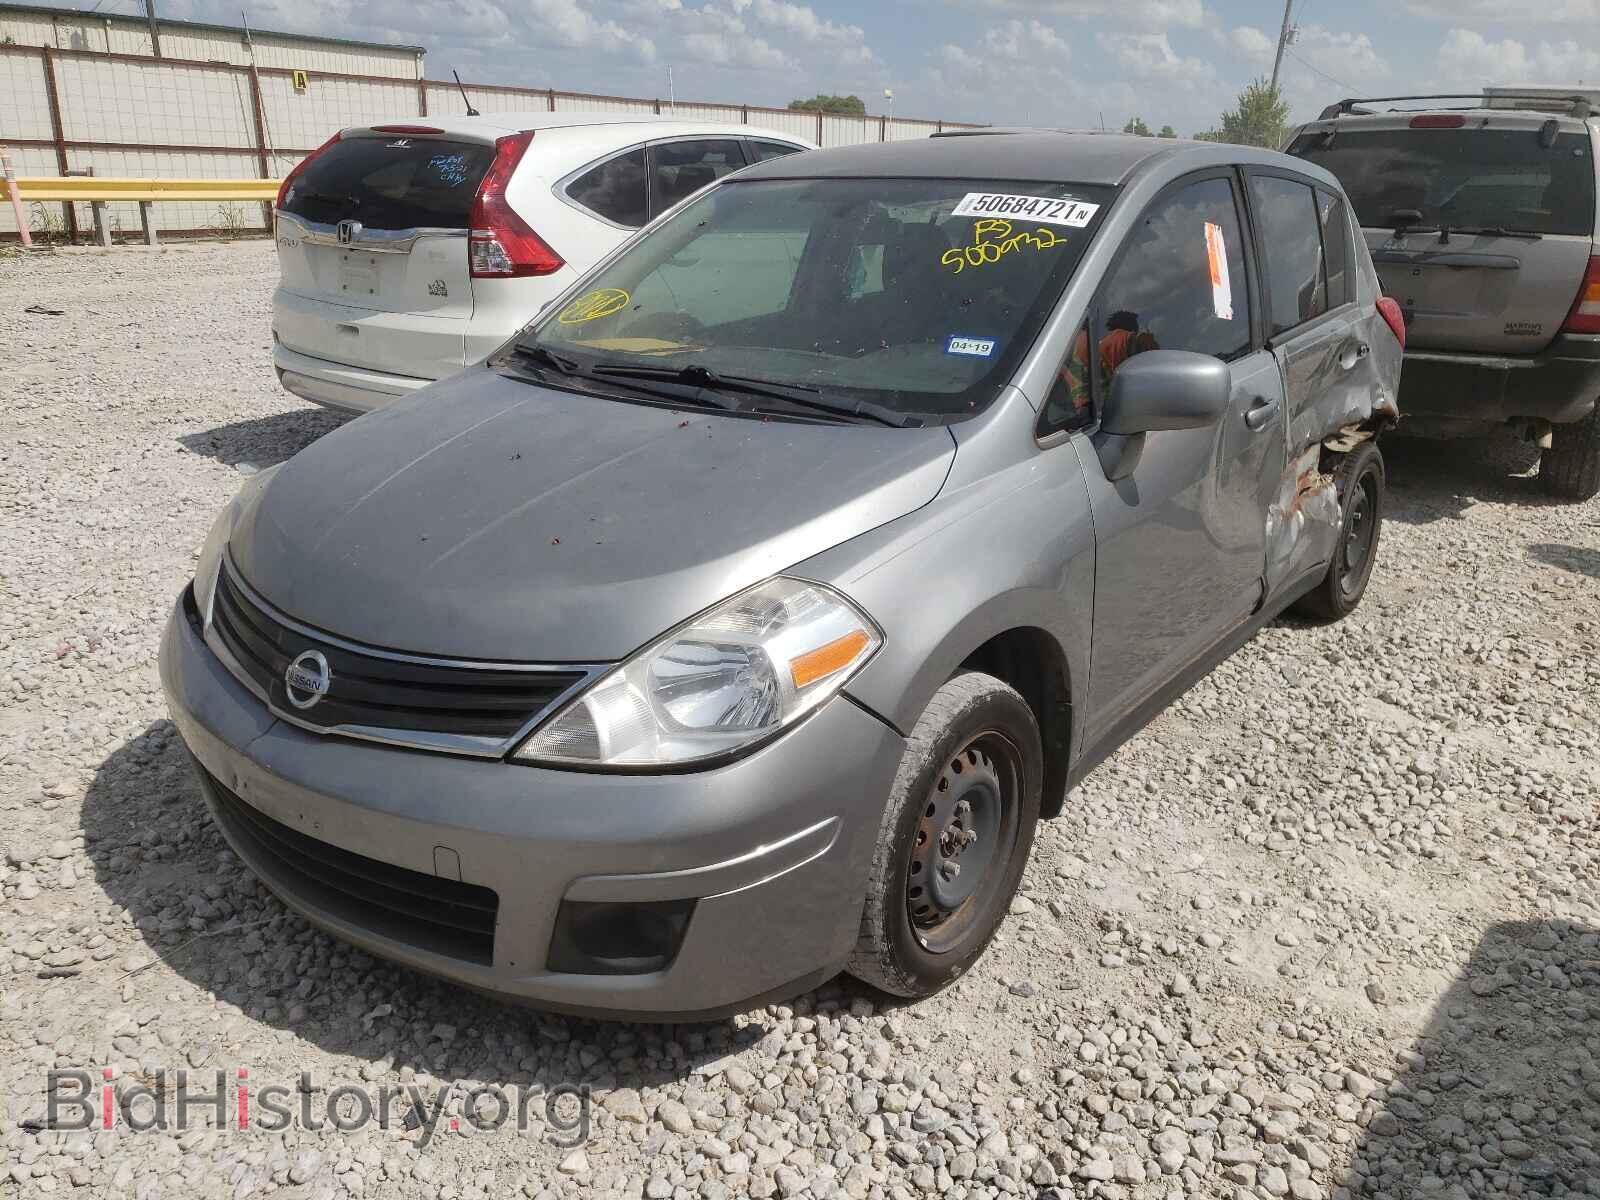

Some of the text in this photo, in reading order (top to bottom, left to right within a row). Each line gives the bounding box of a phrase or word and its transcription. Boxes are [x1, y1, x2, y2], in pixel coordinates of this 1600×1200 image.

[297, 71, 306, 88] A
[972, 195, 1077, 220] 50684721
[1075, 210, 1089, 220] N
